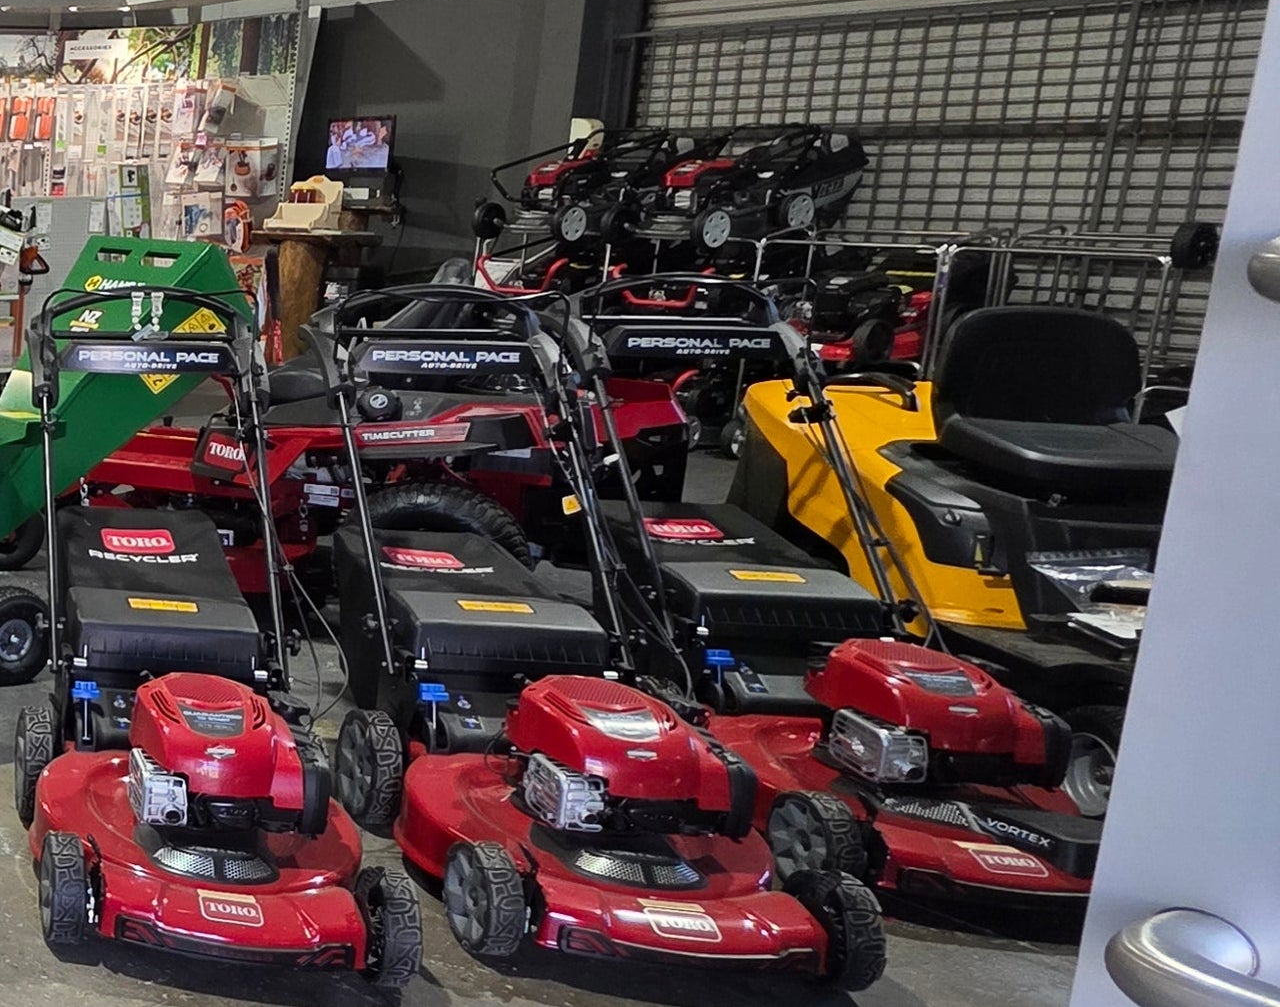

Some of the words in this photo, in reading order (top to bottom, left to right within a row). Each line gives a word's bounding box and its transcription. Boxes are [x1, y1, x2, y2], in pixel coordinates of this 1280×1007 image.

[79, 309, 103, 324] NZ
[627, 337, 723, 348] PERSONAL
[729, 338, 771, 349] PACE
[78, 350, 171, 363] PERSONAL
[176, 352, 220, 364] PACE
[372, 350, 470, 362] PERSONAL
[475, 352, 521, 363] PACE
[124, 362, 178, 370] AUTO-DRIVE
[362, 429, 435, 441] TIMECUTTER
[209, 441, 246, 461] TORO
[107, 534, 171, 547] TORO
[88, 548, 199, 564] RECYCLER
[986, 817, 1052, 847] VORTEX
[980, 854, 1037, 868] TORO
[206, 901, 259, 918] TORO
